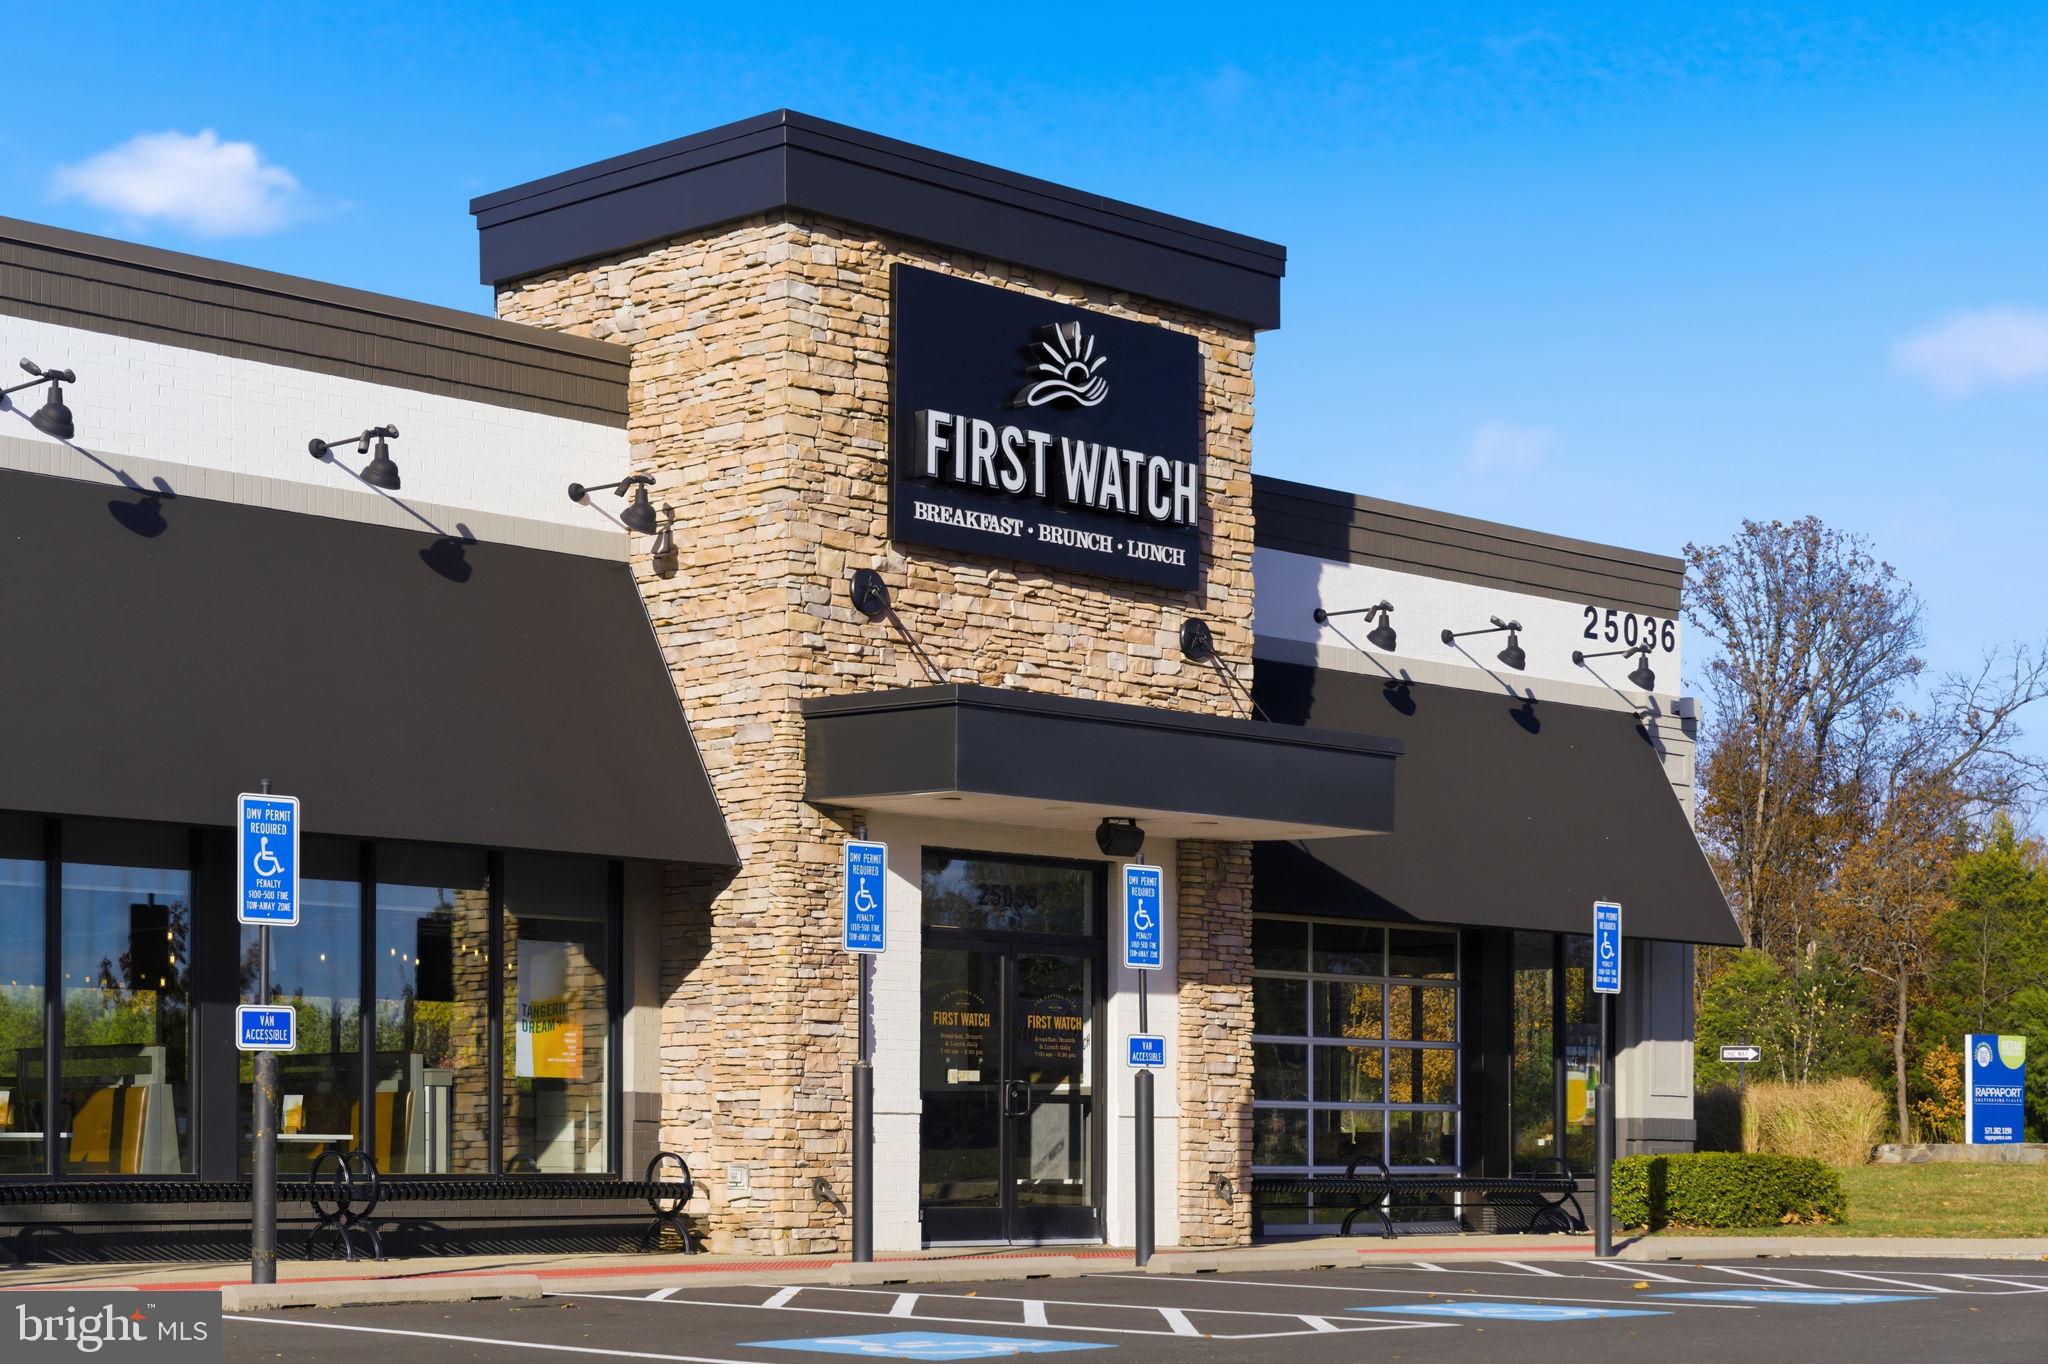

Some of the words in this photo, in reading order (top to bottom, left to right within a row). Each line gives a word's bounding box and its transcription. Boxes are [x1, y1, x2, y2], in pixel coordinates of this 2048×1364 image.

[926, 409, 1053, 498] FIRST
[1061, 437, 1198, 526] WATCH
[913, 501, 1024, 536] BREAKFAST
[1038, 524, 1113, 553] BRUNCH
[1127, 540, 1186, 566] LUNCH
[1584, 606, 1675, 653] 25036
[246, 808, 262, 820] DMV
[265, 809, 291, 822] PERMIT
[250, 822, 287, 835] REQUIRED
[850, 852, 862, 862] DMV
[863, 853, 882, 865] PERMIT
[852, 864, 879, 876] REQUIRED
[256, 879, 281, 889] PENALTY
[1128, 875, 1138, 884] DMV
[1141, 876, 1157, 886] PERMIT
[248, 890, 275, 900] $100-500
[277, 891, 289, 900] FINE
[1131, 887, 1155, 897] REQUIRED
[246, 901, 275, 911] TOW-AWAY
[278, 902, 291, 912] ZONE
[856, 914, 874, 922] PENALTY
[522, 1002, 569, 1018] TANGERIN
[260, 1015, 274, 1027] VAN
[933, 1011, 959, 1026] FIRST
[960, 1012, 990, 1027] WATCH
[1027, 1015, 1052, 1029] FIRST
[1053, 1016, 1082, 1030] WATCH
[521, 1019, 556, 1033] DREAM
[245, 1029, 287, 1040] ACCESSIBLE
[1142, 1041, 1152, 1050] VAN
[1132, 1052, 1162, 1062] ACCESSIBLE
[1975, 1087, 2022, 1097] RAPPAPORT
